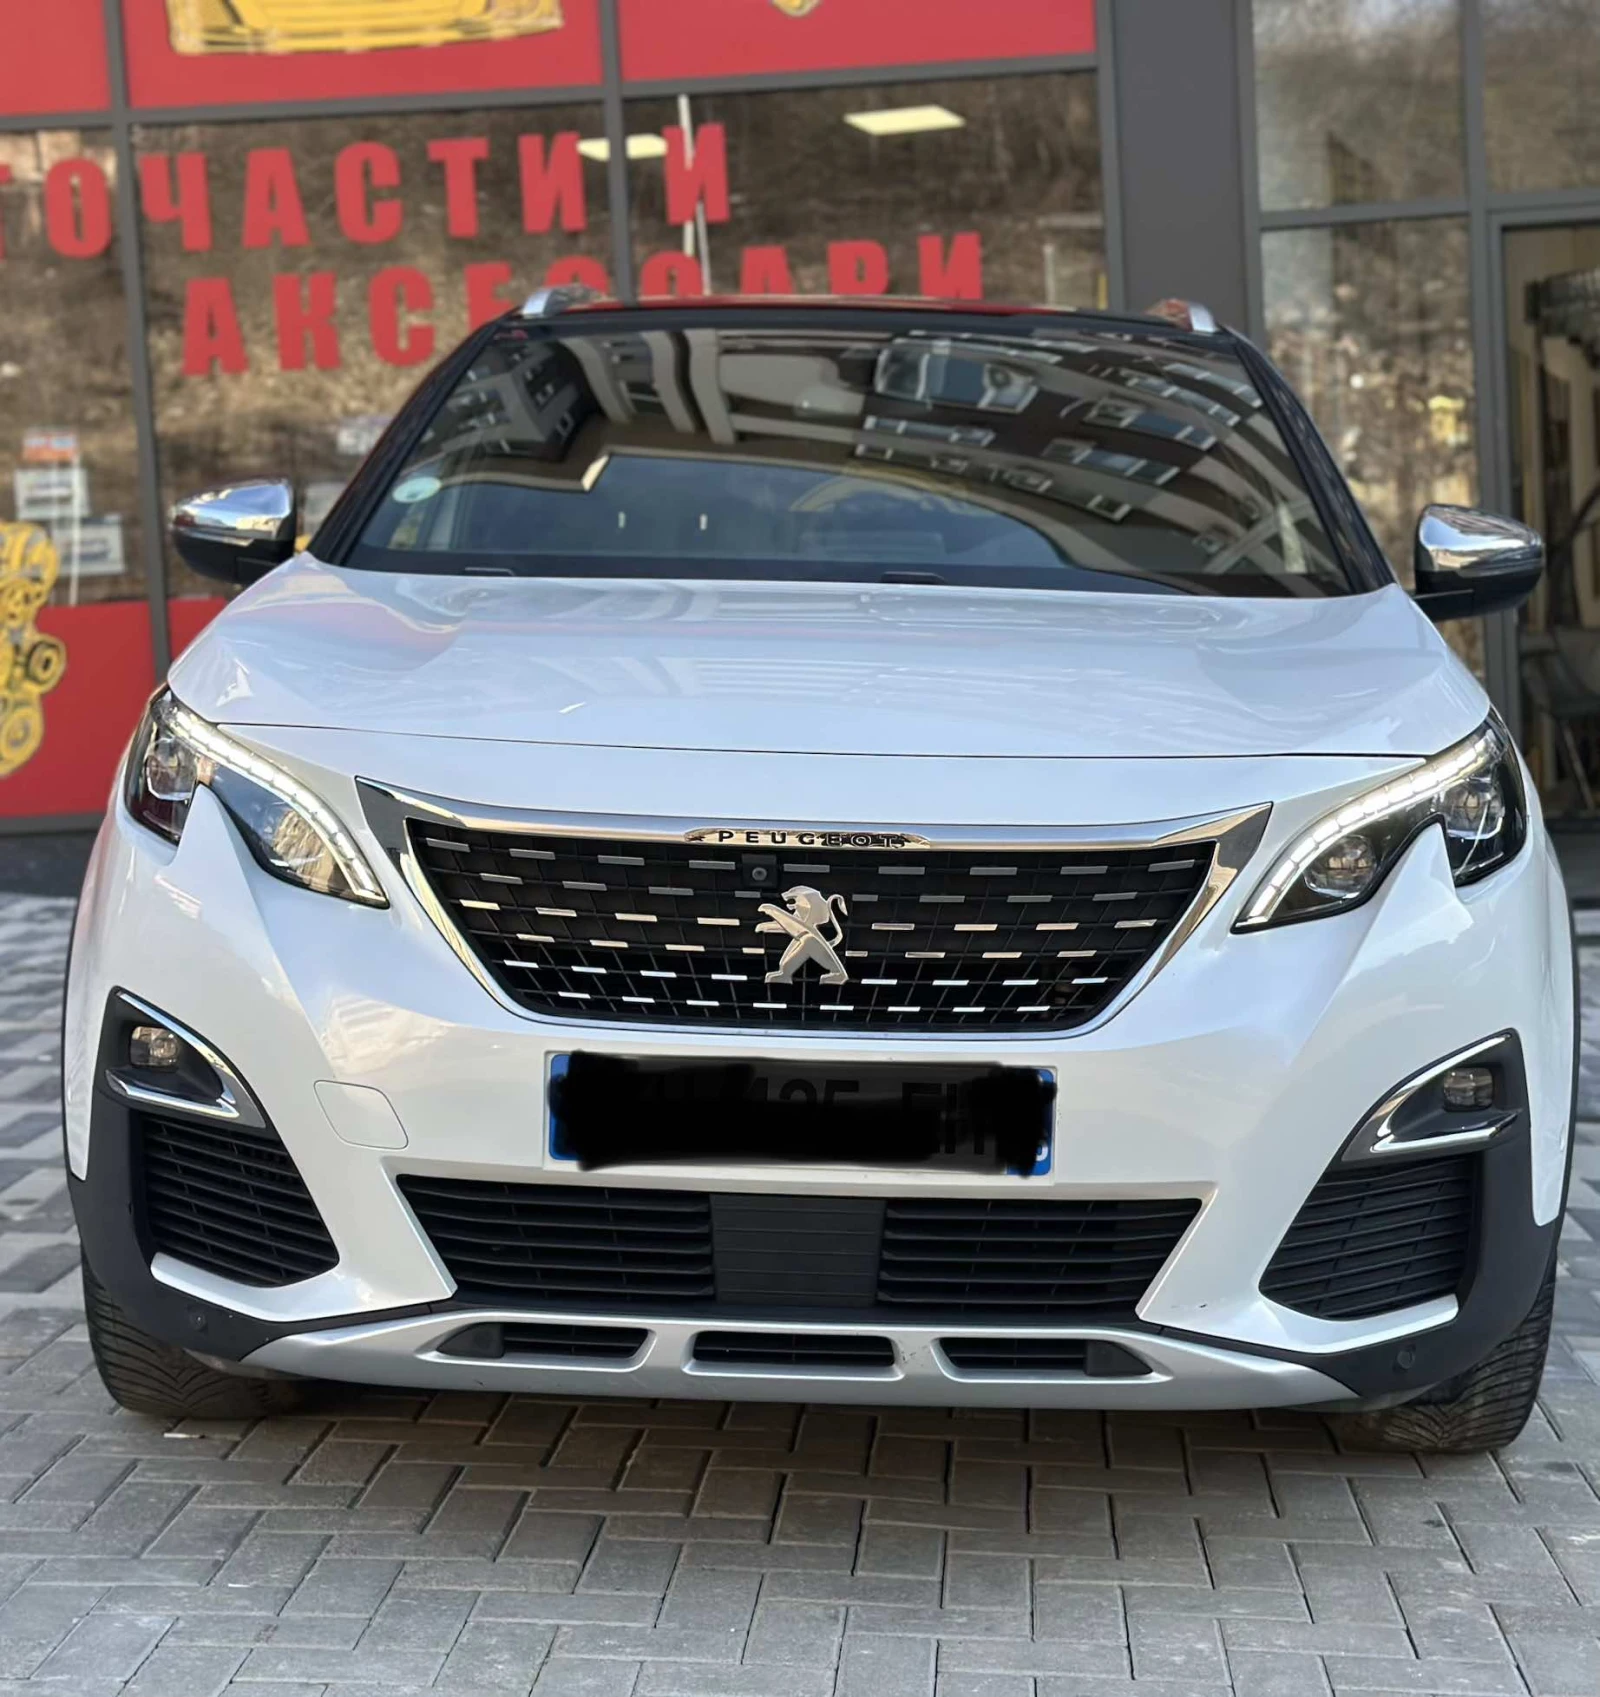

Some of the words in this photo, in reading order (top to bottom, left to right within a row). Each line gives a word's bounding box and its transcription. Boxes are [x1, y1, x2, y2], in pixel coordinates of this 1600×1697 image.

[0, 133, 587, 259] ОЧАСТИ
[663, 123, 730, 225] И
[718, 829, 901, 848] PEUGEOT
